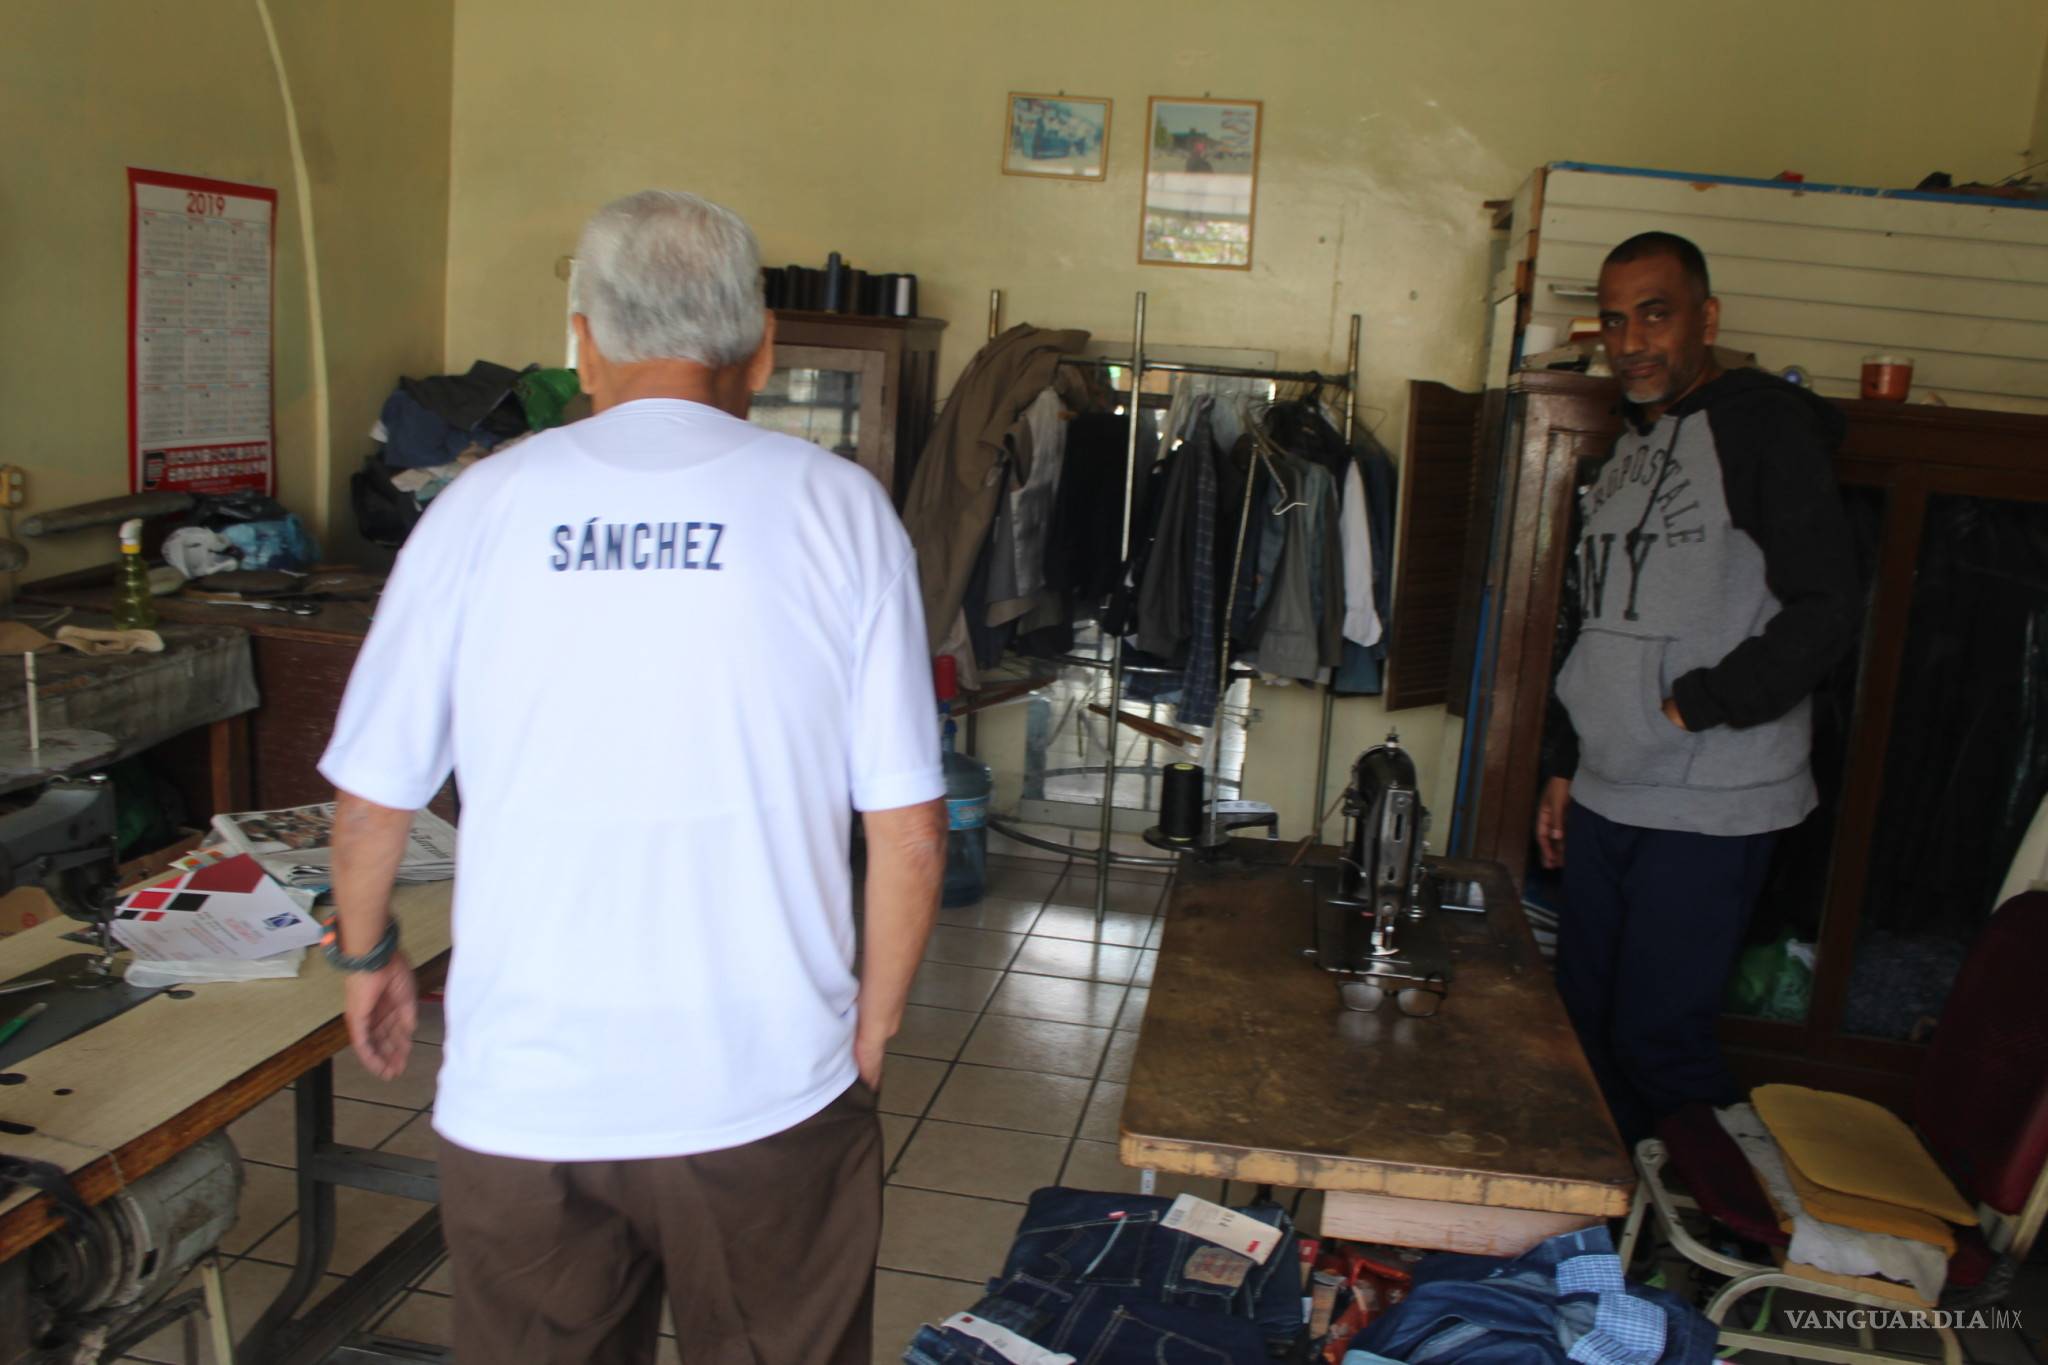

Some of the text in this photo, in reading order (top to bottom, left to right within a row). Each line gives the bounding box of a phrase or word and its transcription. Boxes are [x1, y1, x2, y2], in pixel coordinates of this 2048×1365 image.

[186, 192, 227, 216] 2019
[550, 516, 726, 572] SÁNCHEZ
[1580, 532, 1659, 621] NY
